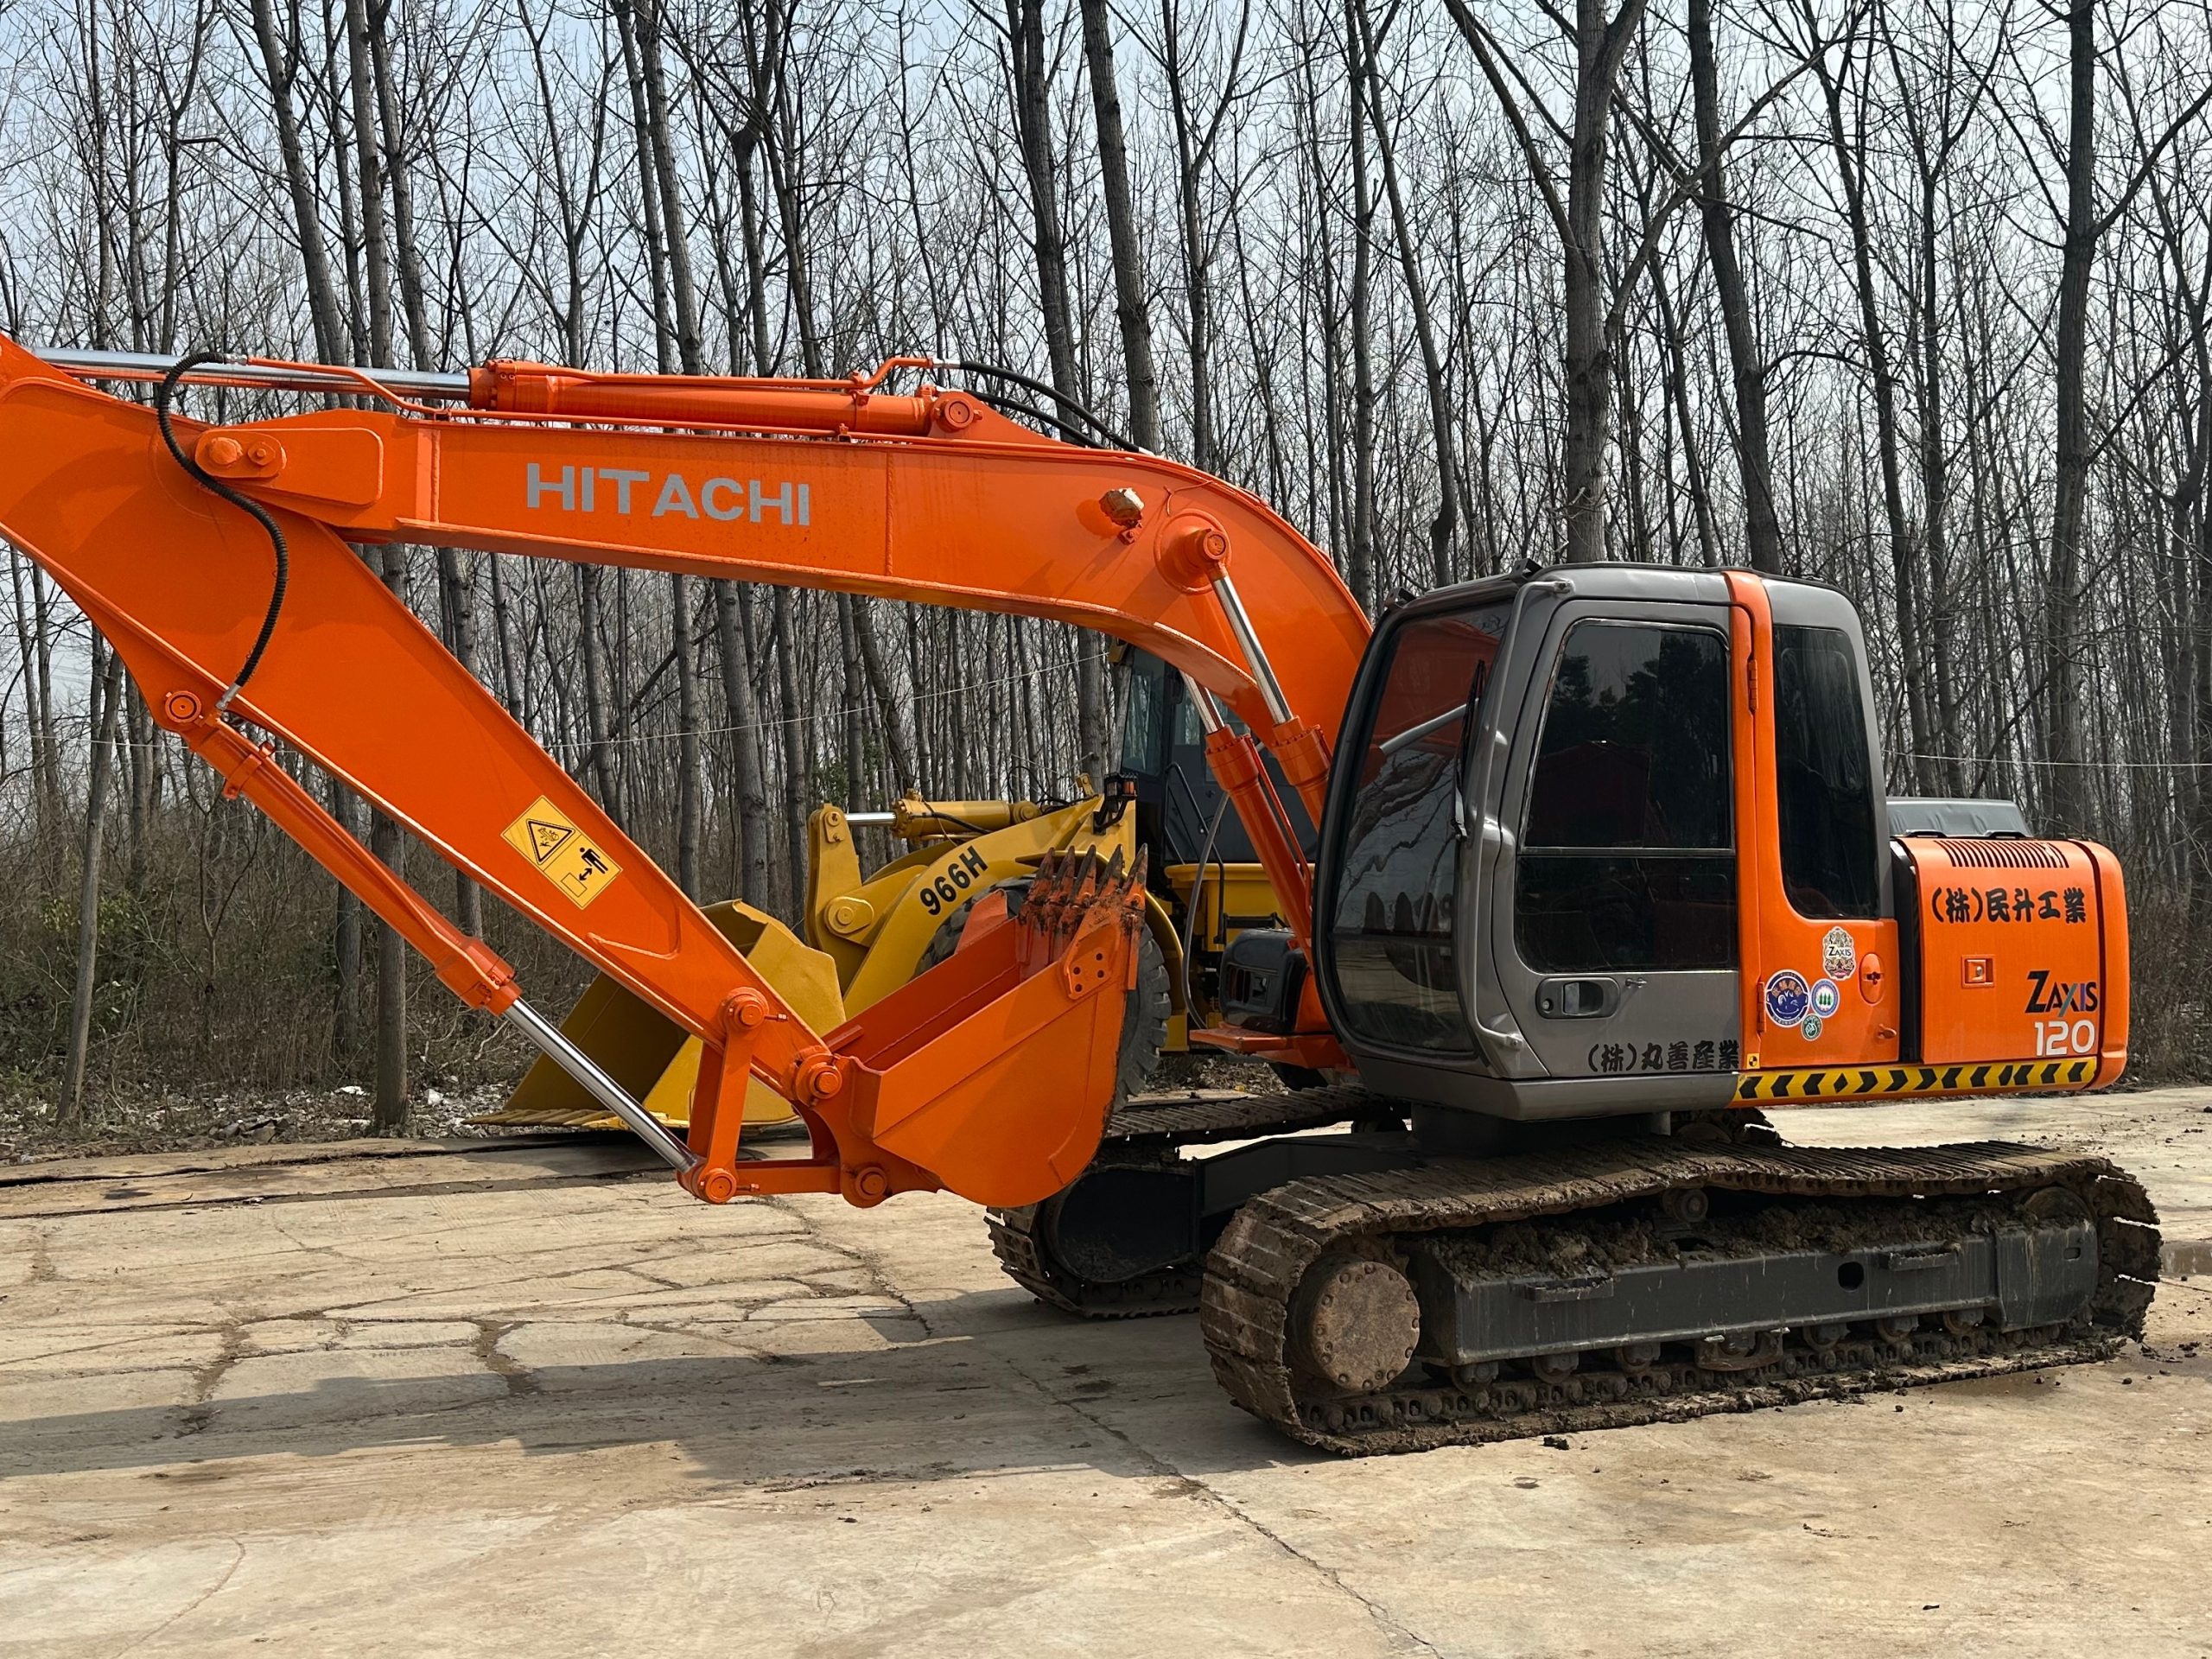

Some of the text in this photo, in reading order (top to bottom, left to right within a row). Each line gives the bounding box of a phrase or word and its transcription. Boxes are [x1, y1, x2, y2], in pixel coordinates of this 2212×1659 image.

[527, 462, 810, 526] HITACHI
[919, 845, 988, 916] 966H
[1828, 946, 1852, 957] ZAXIS
[2024, 969, 2098, 1018] ZAXIS
[2034, 1020, 2095, 1056] 120
